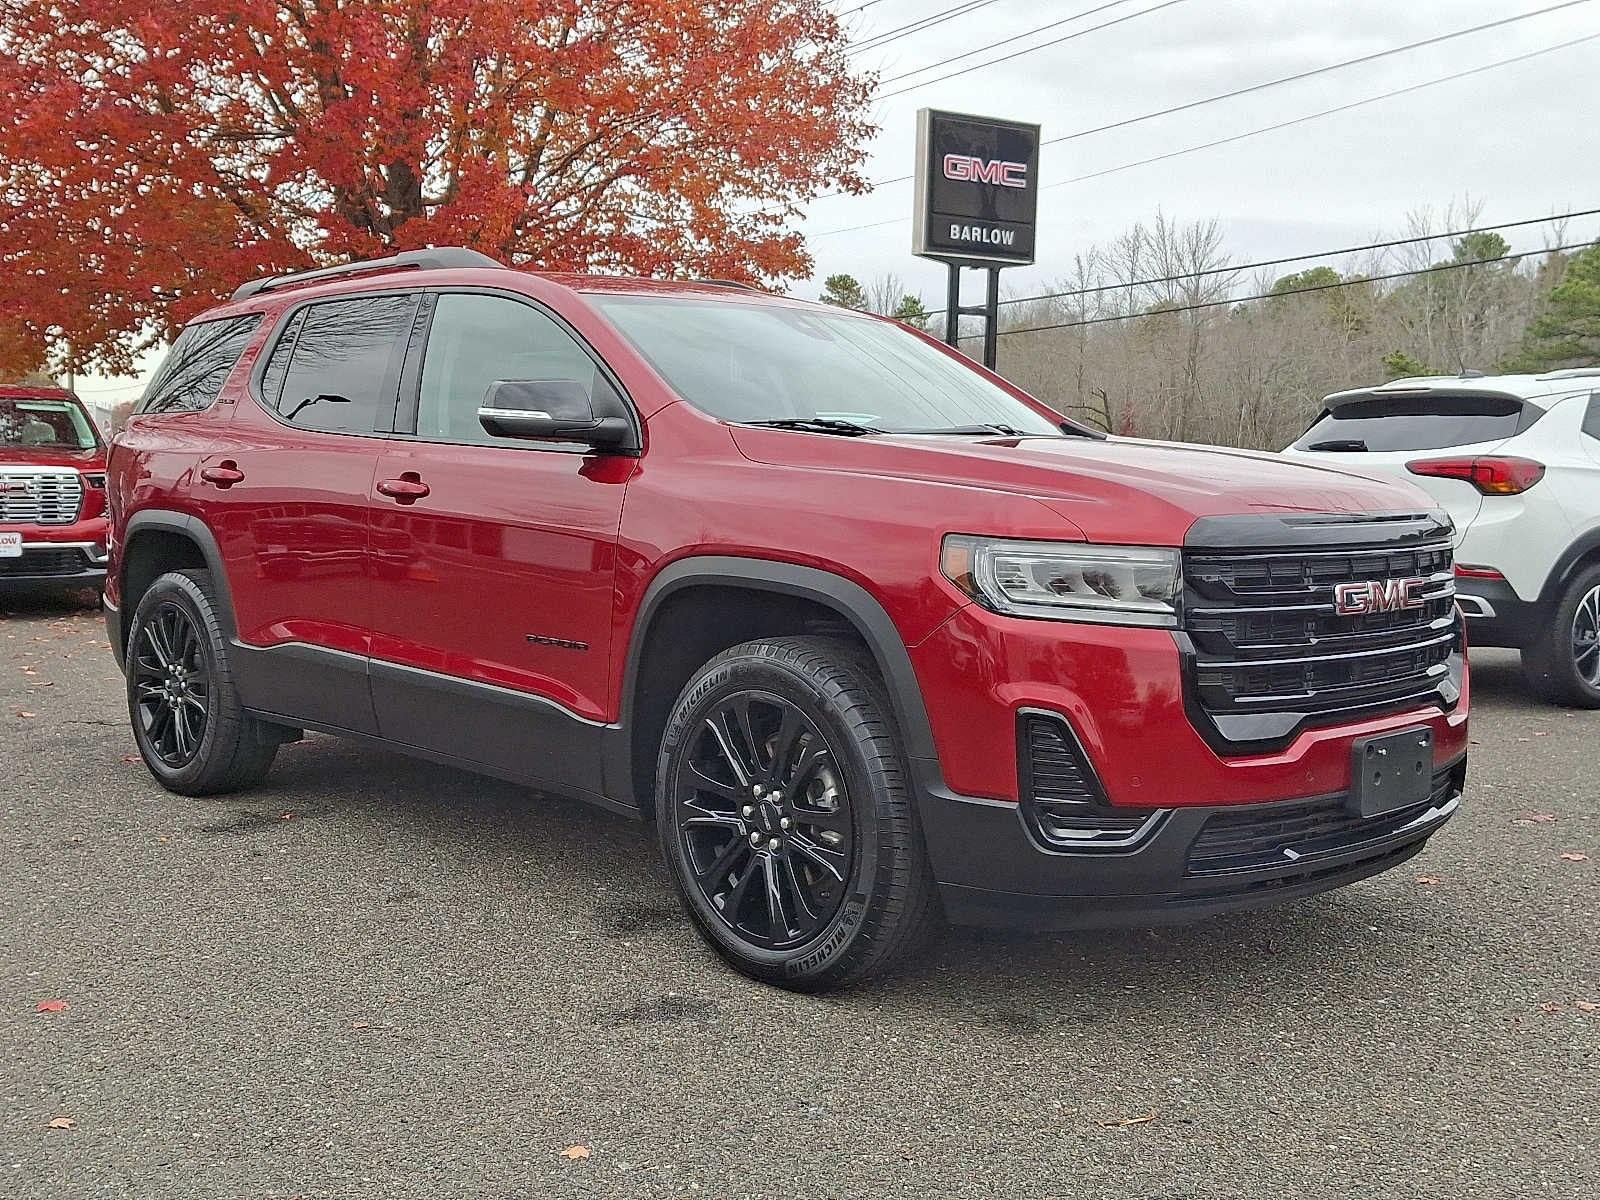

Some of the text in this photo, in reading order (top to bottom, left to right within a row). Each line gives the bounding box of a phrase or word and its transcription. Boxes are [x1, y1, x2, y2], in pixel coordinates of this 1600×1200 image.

[944, 154, 1027, 188] GMC
[950, 224, 1015, 245] BARLOW
[1335, 578, 1424, 615] GMC
[679, 668, 730, 722] MICHELIN
[790, 926, 847, 975] MICHELIN
